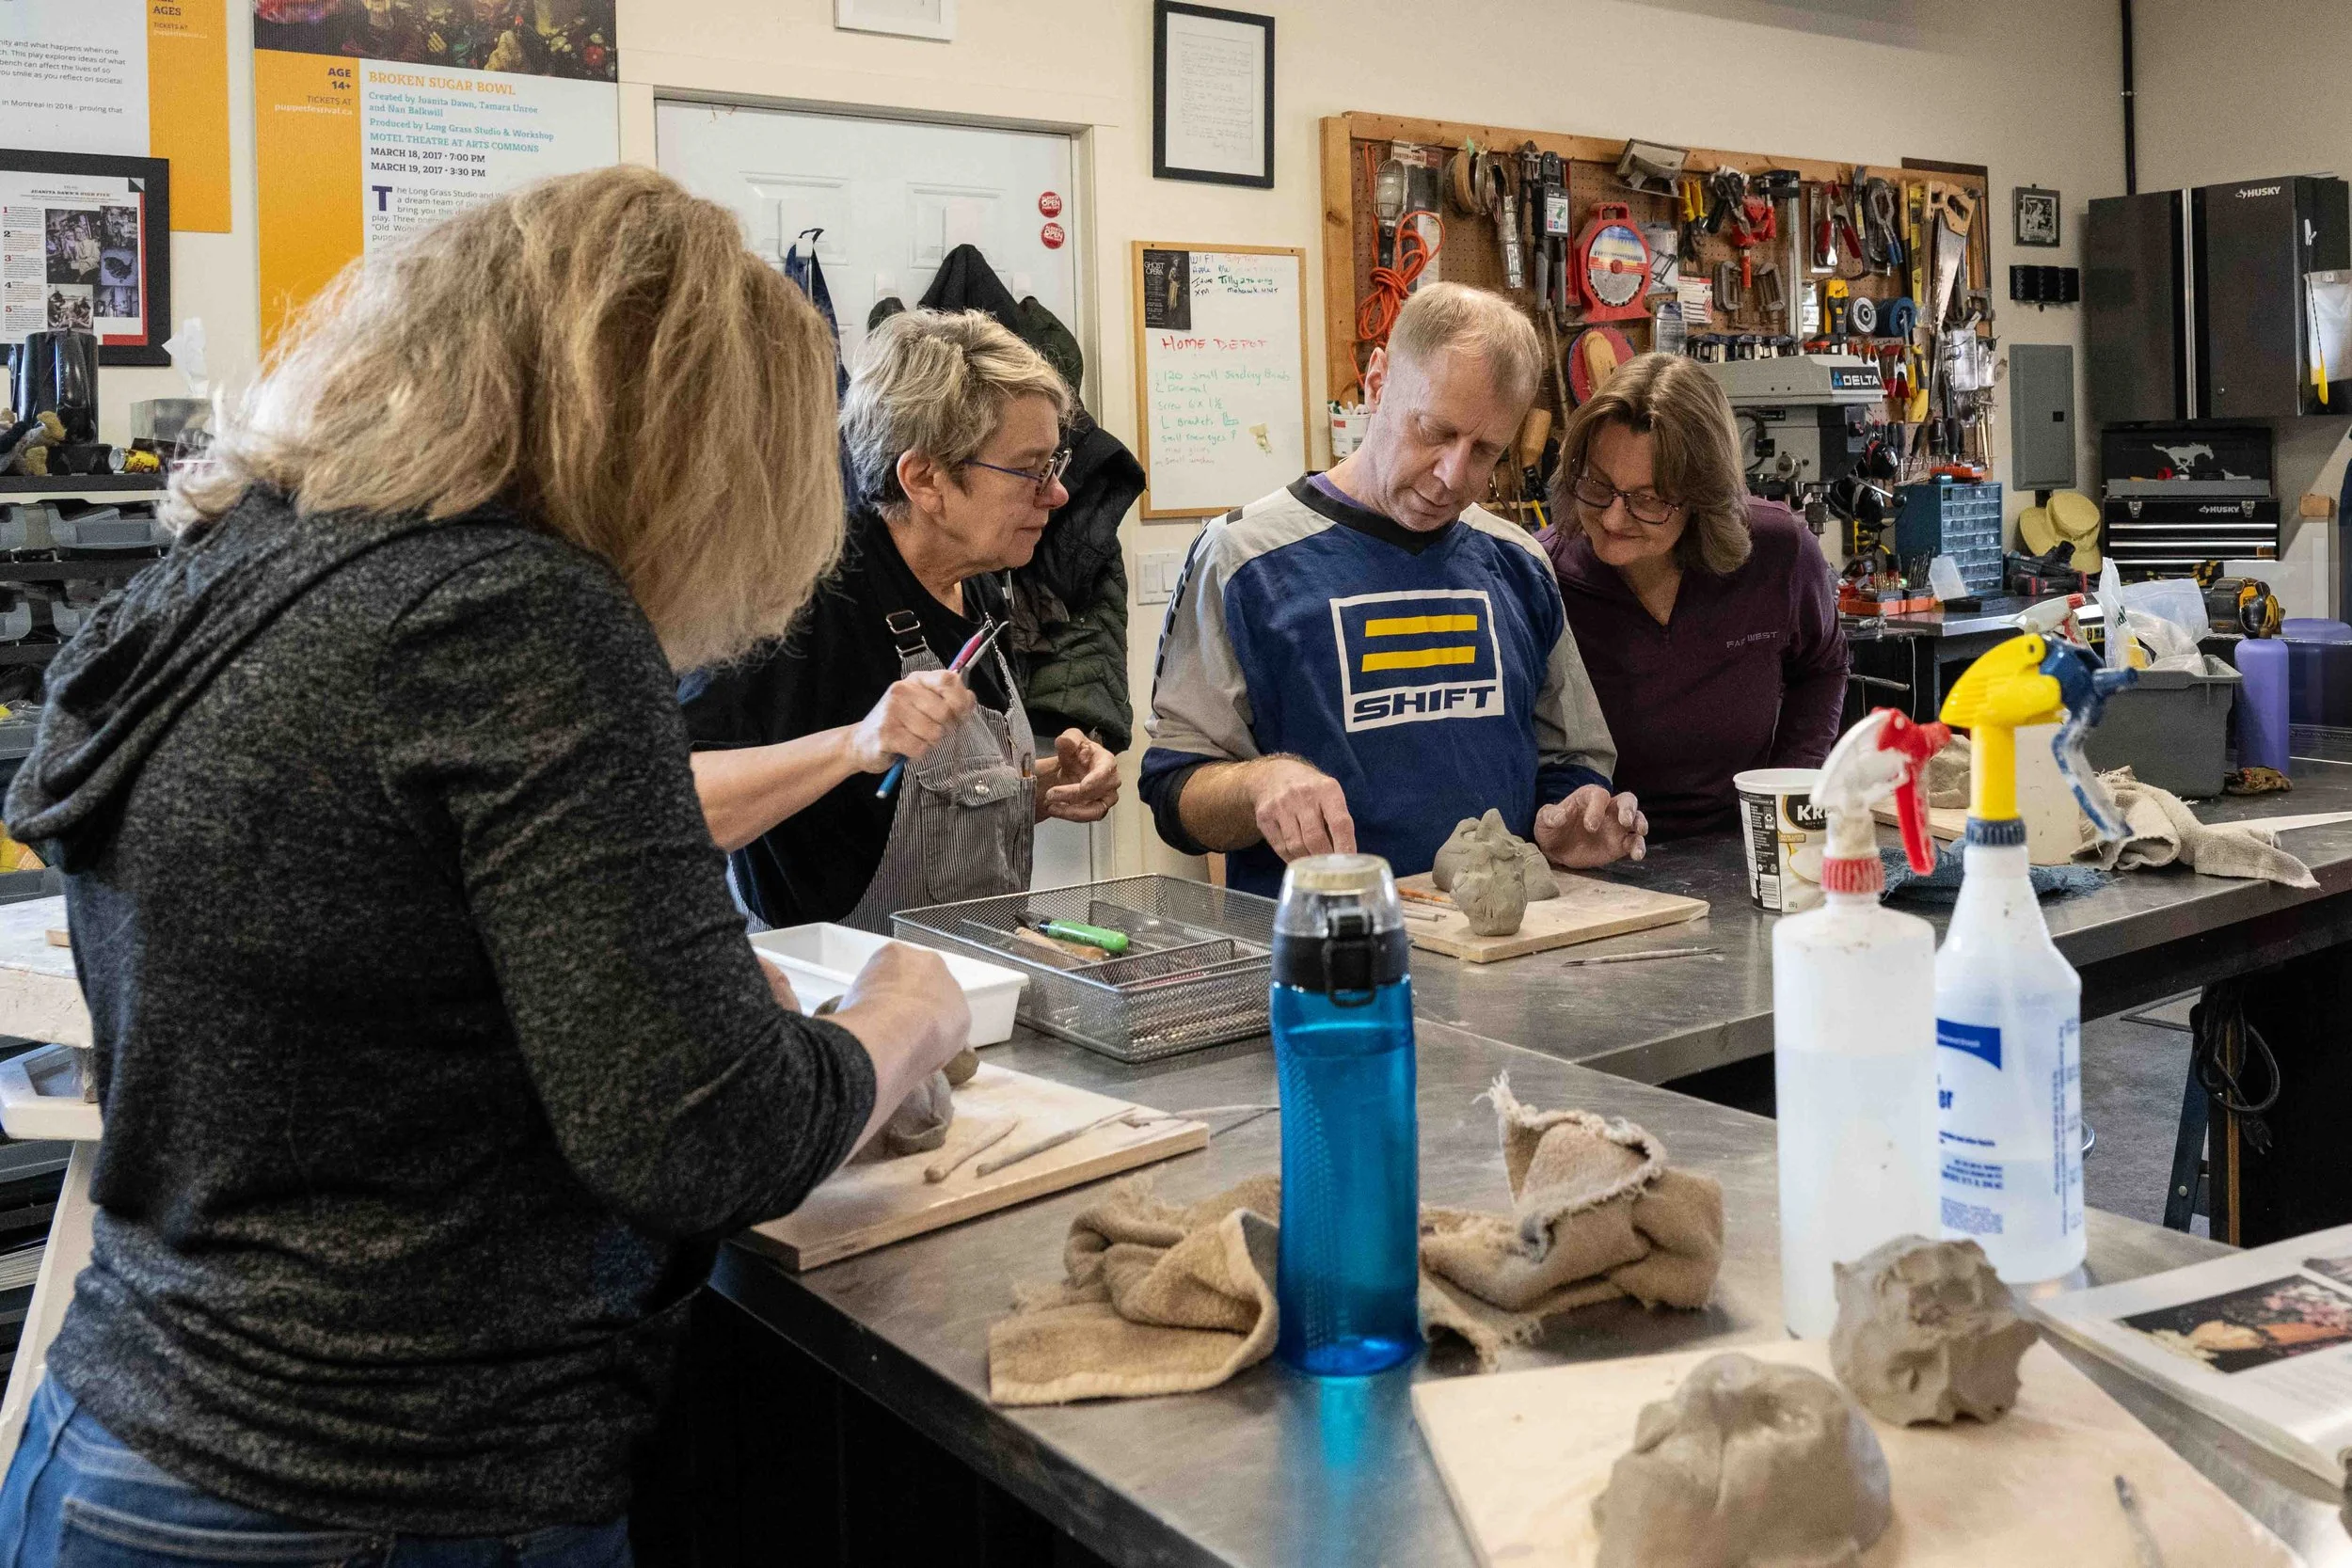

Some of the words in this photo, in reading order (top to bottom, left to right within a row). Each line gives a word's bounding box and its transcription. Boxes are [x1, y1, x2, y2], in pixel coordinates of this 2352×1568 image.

[153, 6, 182, 16] AGES
[153, 22, 179, 30] TICKETS
[50, 43, 82, 53] happens
[28, 51, 43, 60] play
[45, 53, 76, 62] explores
[78, 55, 97, 63] ideas
[108, 57, 126, 66] what
[39, 61, 60, 70] affect
[75, 64, 91, 72] lives
[327, 67, 351, 77] AGE
[59, 72, 83, 82] reflect
[95, 75, 123, 85] societal
[369, 71, 425, 87] BROKEN
[428, 77, 473, 91] SUGAR
[477, 82, 516, 96] BOWL
[331, 80, 352, 90] 14+
[308, 95, 341, 105] TICKETS
[369, 92, 403, 103] Created
[405, 93, 415, 104] by
[418, 95, 449, 106] Juanita
[451, 99, 477, 110] Dawn,
[479, 101, 511, 112] Tamara
[10, 100, 45, 108] Montreal
[79, 105, 106, 114] proving
[274, 103, 353, 116] puppetfestival.ca
[388, 104, 405, 114] Nan
[407, 106, 443, 118] Balkwill
[369, 118, 410, 129] Produced
[413, 119, 423, 131] by
[425, 121, 447, 134] Long
[449, 124, 472, 135] Grass
[474, 125, 501, 136] Studio
[502, 128, 511, 136] &
[513, 130, 554, 141] Workshop
[370, 133, 405, 143] MOTEL
[406, 135, 450, 147] THEATRE
[452, 136, 464, 147] AT
[466, 138, 490, 150] ARTS
[491, 141, 539, 152] COMMONS
[370, 147, 405, 158] MARCH
[408, 150, 421, 160] 18,
[422, 150, 442, 160] 2017
[450, 152, 469, 162] 7:00
[470, 154, 485, 164] PM
[371, 162, 406, 172] MARCH
[408, 165, 421, 174] 19,
[422, 166, 442, 175] 2017
[450, 167, 469, 176] 3:30
[471, 168, 485, 178] PM
[408, 188, 428, 197] Long
[429, 188, 452, 197] Grass
[453, 189, 478, 198] Studio
[2248, 186, 2280, 198] HUSKY
[397, 206, 419, 215] bring
[392, 214, 416, 223] Three
[1843, 375, 1881, 387] DELTA
[2210, 505, 2240, 514] HUSKY
[1353, 686, 1496, 723] SHIFT
